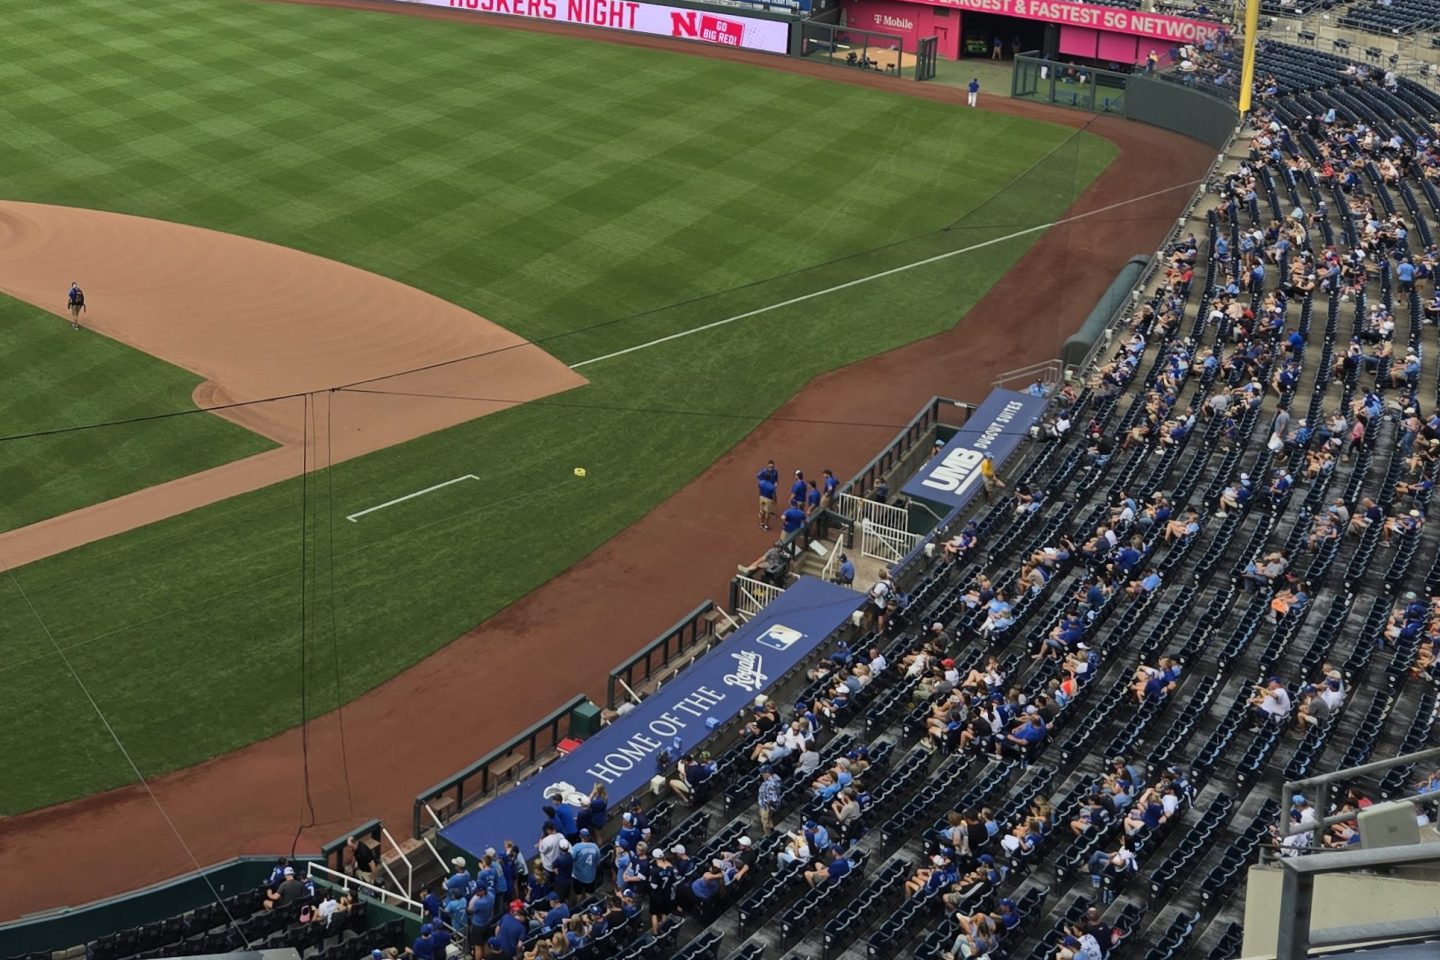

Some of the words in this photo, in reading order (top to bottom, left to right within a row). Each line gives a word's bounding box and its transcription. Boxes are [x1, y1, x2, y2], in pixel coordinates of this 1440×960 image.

[671, 12, 698, 37] N
[716, 21, 727, 31] GO
[883, 15, 913, 30] Mobile
[1015, 0, 1026, 14] &
[1030, 0, 1100, 26] FASTEST
[1103, 12, 1127, 29] 5G
[1131, 15, 1218, 41] NETWORK
[703, 30, 717, 41] BIG
[1001, 400, 1024, 427] SUITES
[922, 447, 984, 492] UMB
[586, 732, 662, 784] HOME
[649, 712, 687, 737] OF
[672, 686, 726, 717] THE
[723, 650, 768, 691] Royals
[585, 854, 593, 866] 4
[661, 876, 669, 889] 7
